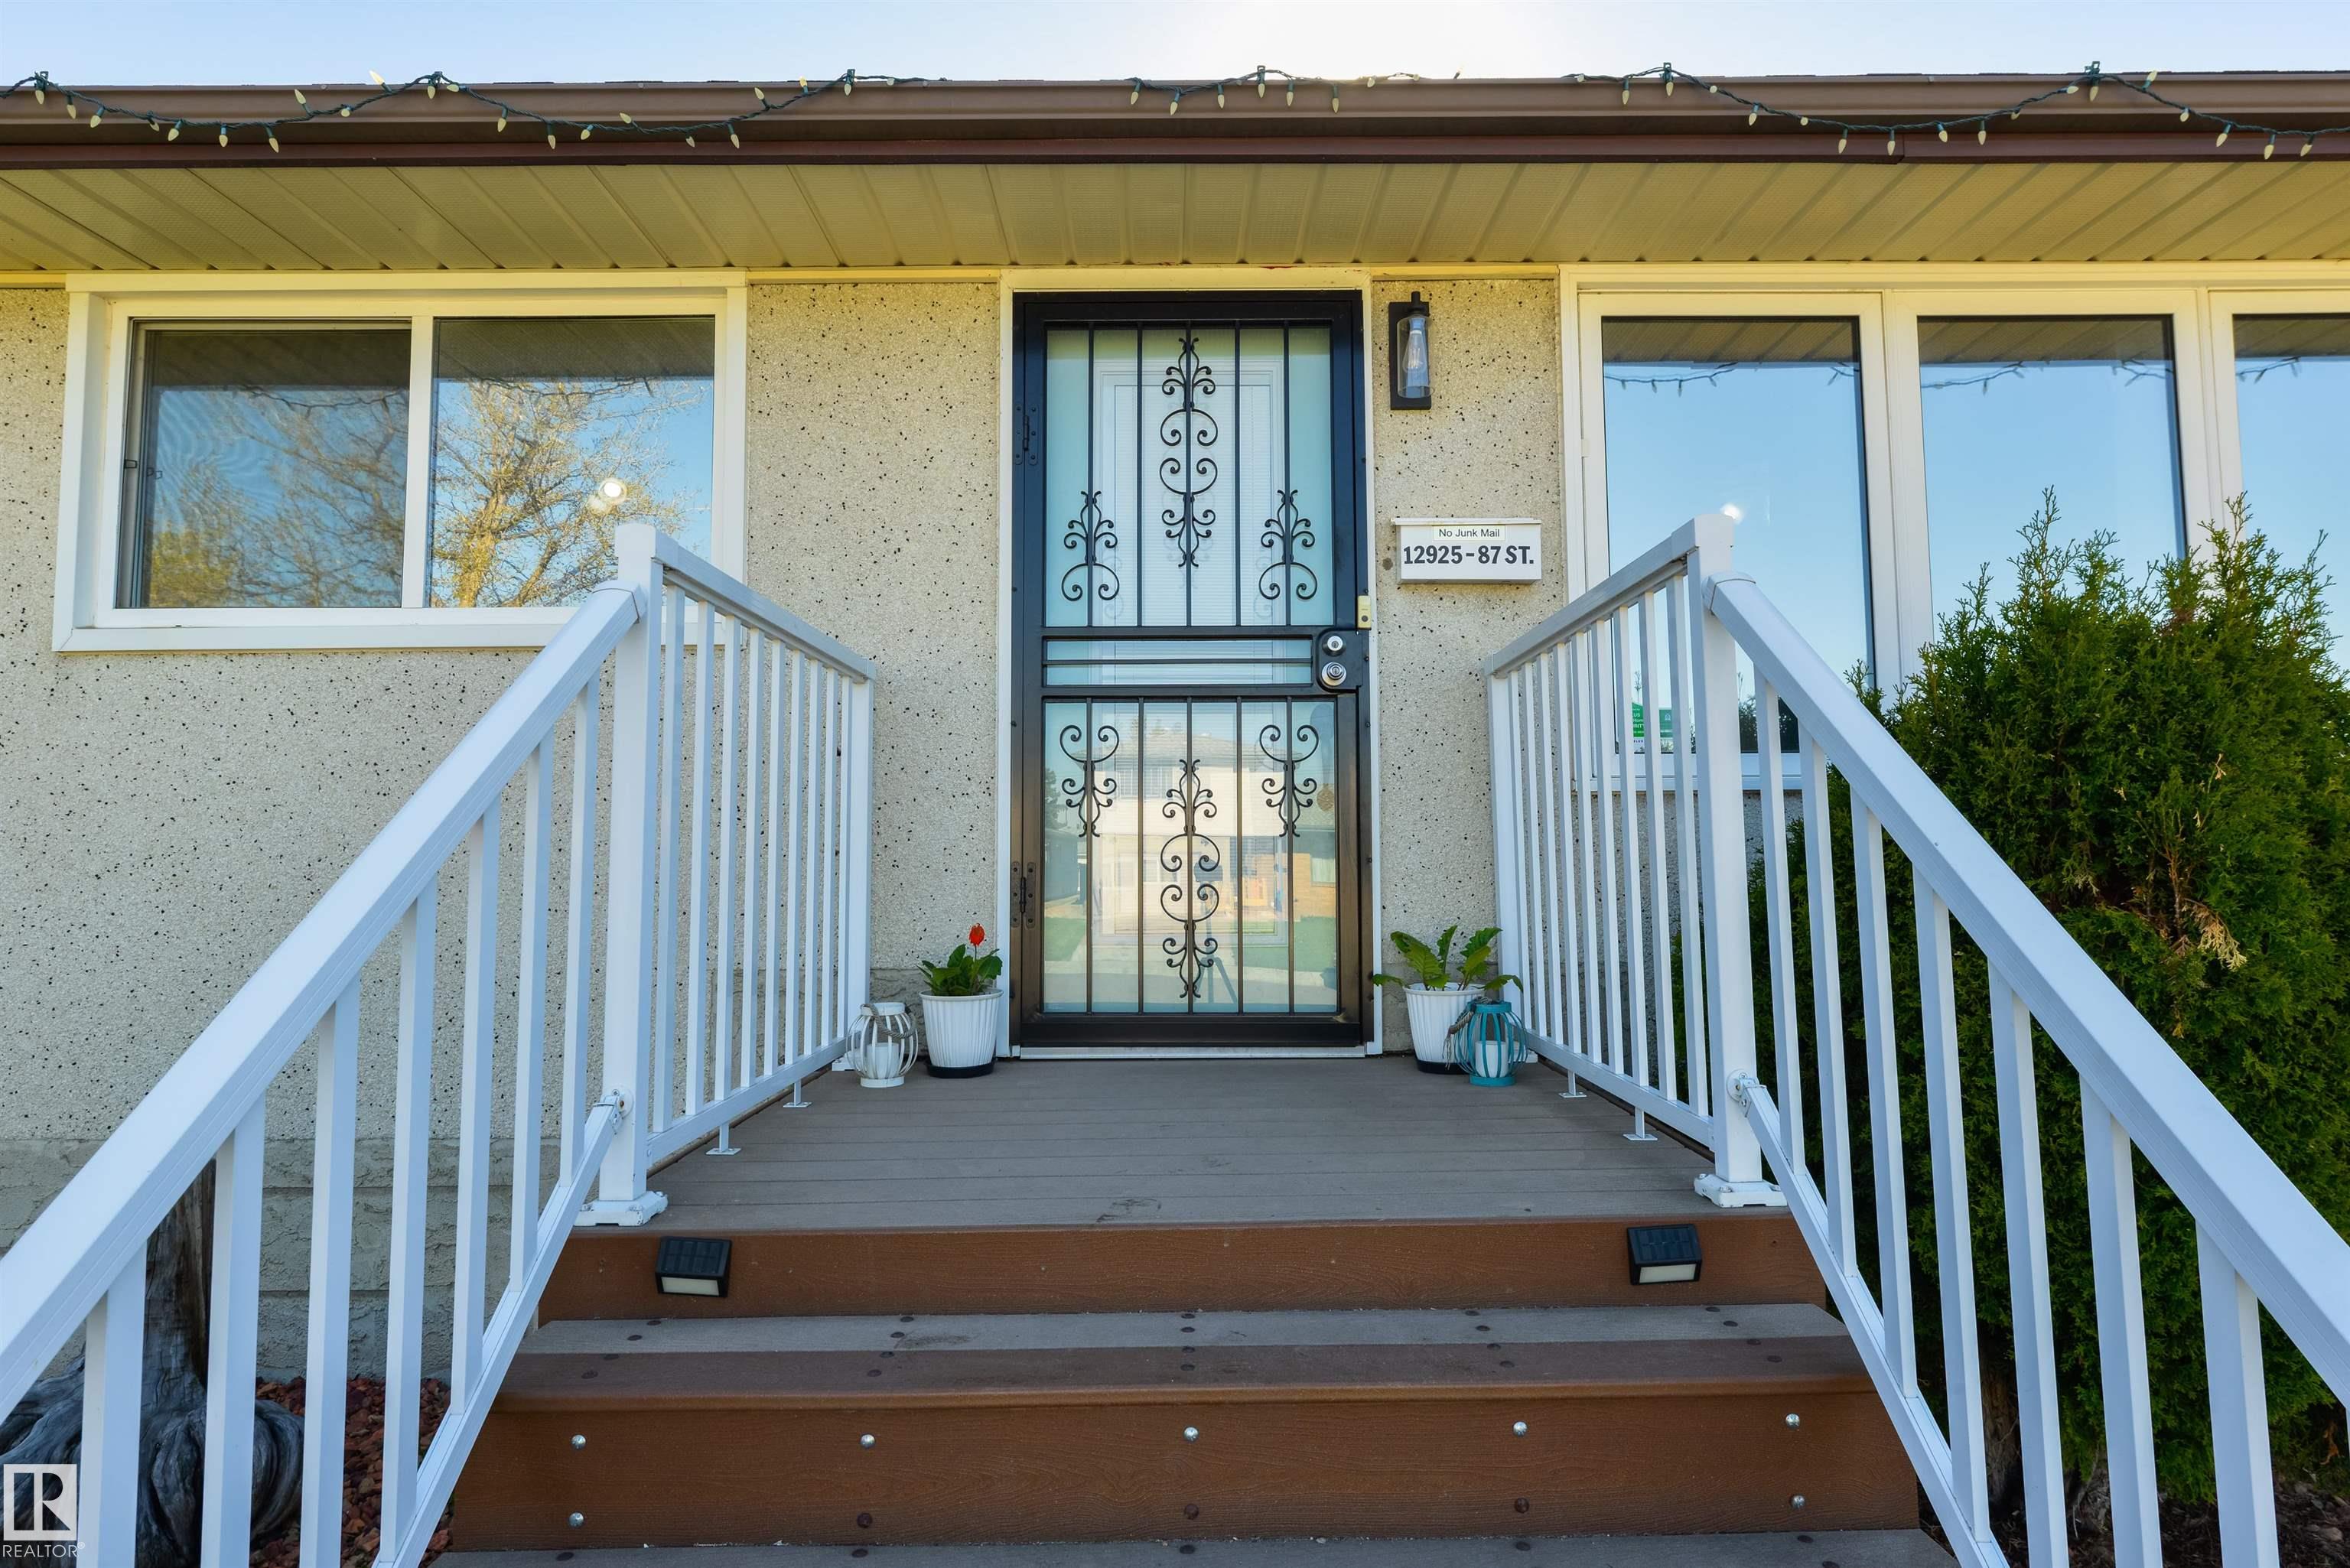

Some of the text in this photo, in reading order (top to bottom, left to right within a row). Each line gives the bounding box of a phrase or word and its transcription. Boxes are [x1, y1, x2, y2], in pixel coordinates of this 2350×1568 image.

[1439, 529, 1500, 538] No Junk Mail
[1505, 545, 1535, 564] ST.
